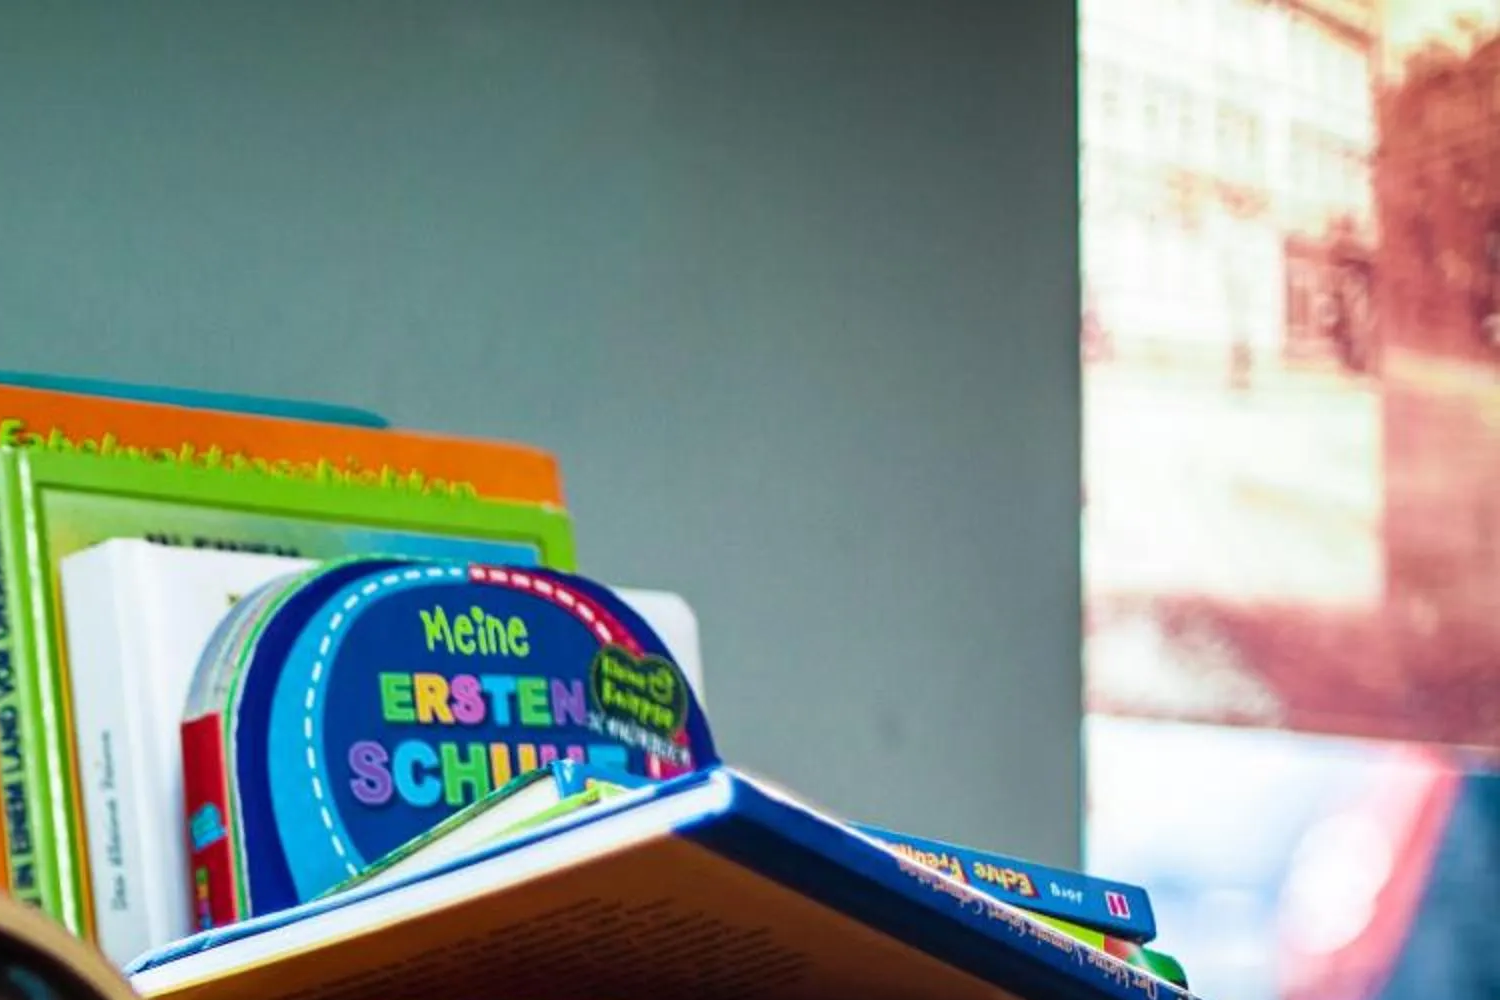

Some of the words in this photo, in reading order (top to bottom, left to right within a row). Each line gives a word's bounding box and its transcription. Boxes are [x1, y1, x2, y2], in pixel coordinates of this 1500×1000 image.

[419, 604, 532, 658] Meine
[378, 671, 587, 726] ERSTEN
[972, 861, 1040, 898] Echte
